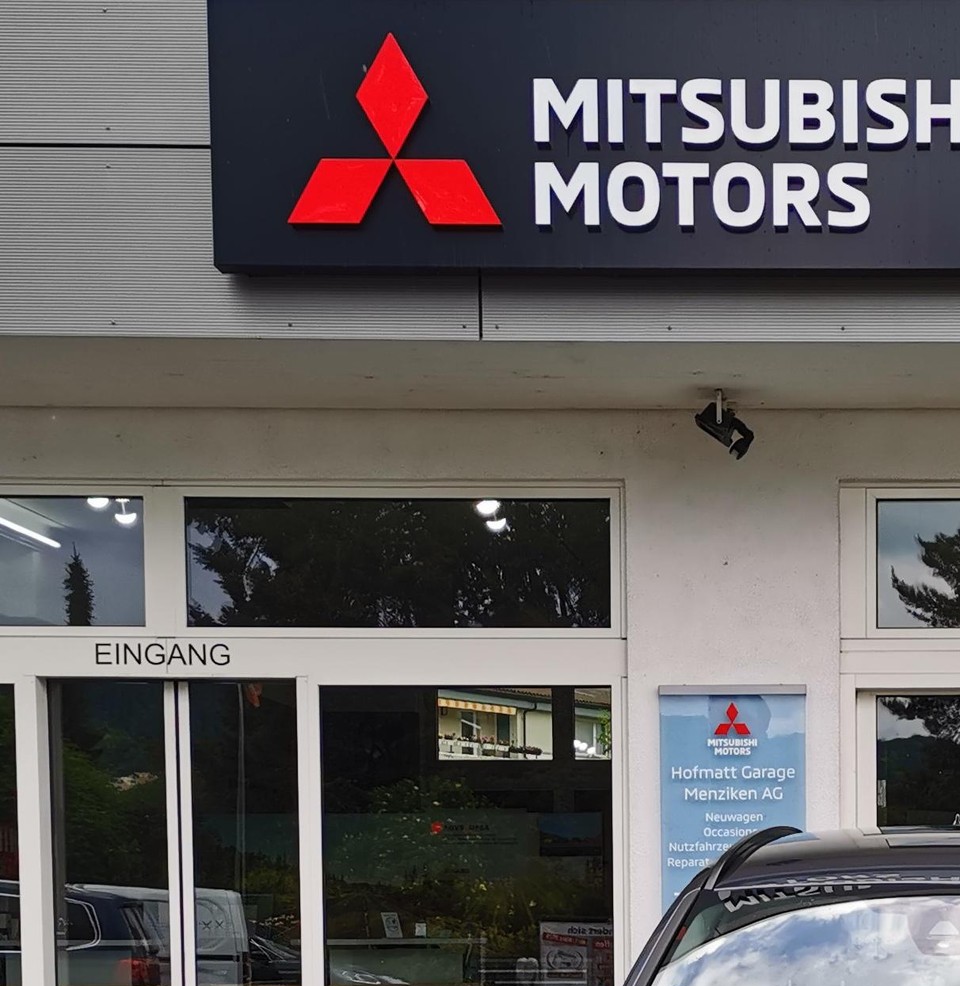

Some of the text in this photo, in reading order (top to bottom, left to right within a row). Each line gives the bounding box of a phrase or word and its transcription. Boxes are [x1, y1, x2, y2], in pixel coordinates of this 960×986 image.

[533, 160, 872, 230] MOTORS
[95, 642, 231, 666] EINGANG
[707, 738, 758, 747] MITSUBISHI
[714, 747, 751, 756] MOTORS
[671, 765, 796, 782] Hofmatt Garage
[684, 786, 784, 801] Menziken AG
[705, 812, 764, 824] Neuwagen
[668, 841, 731, 852] Nutzfahrze
